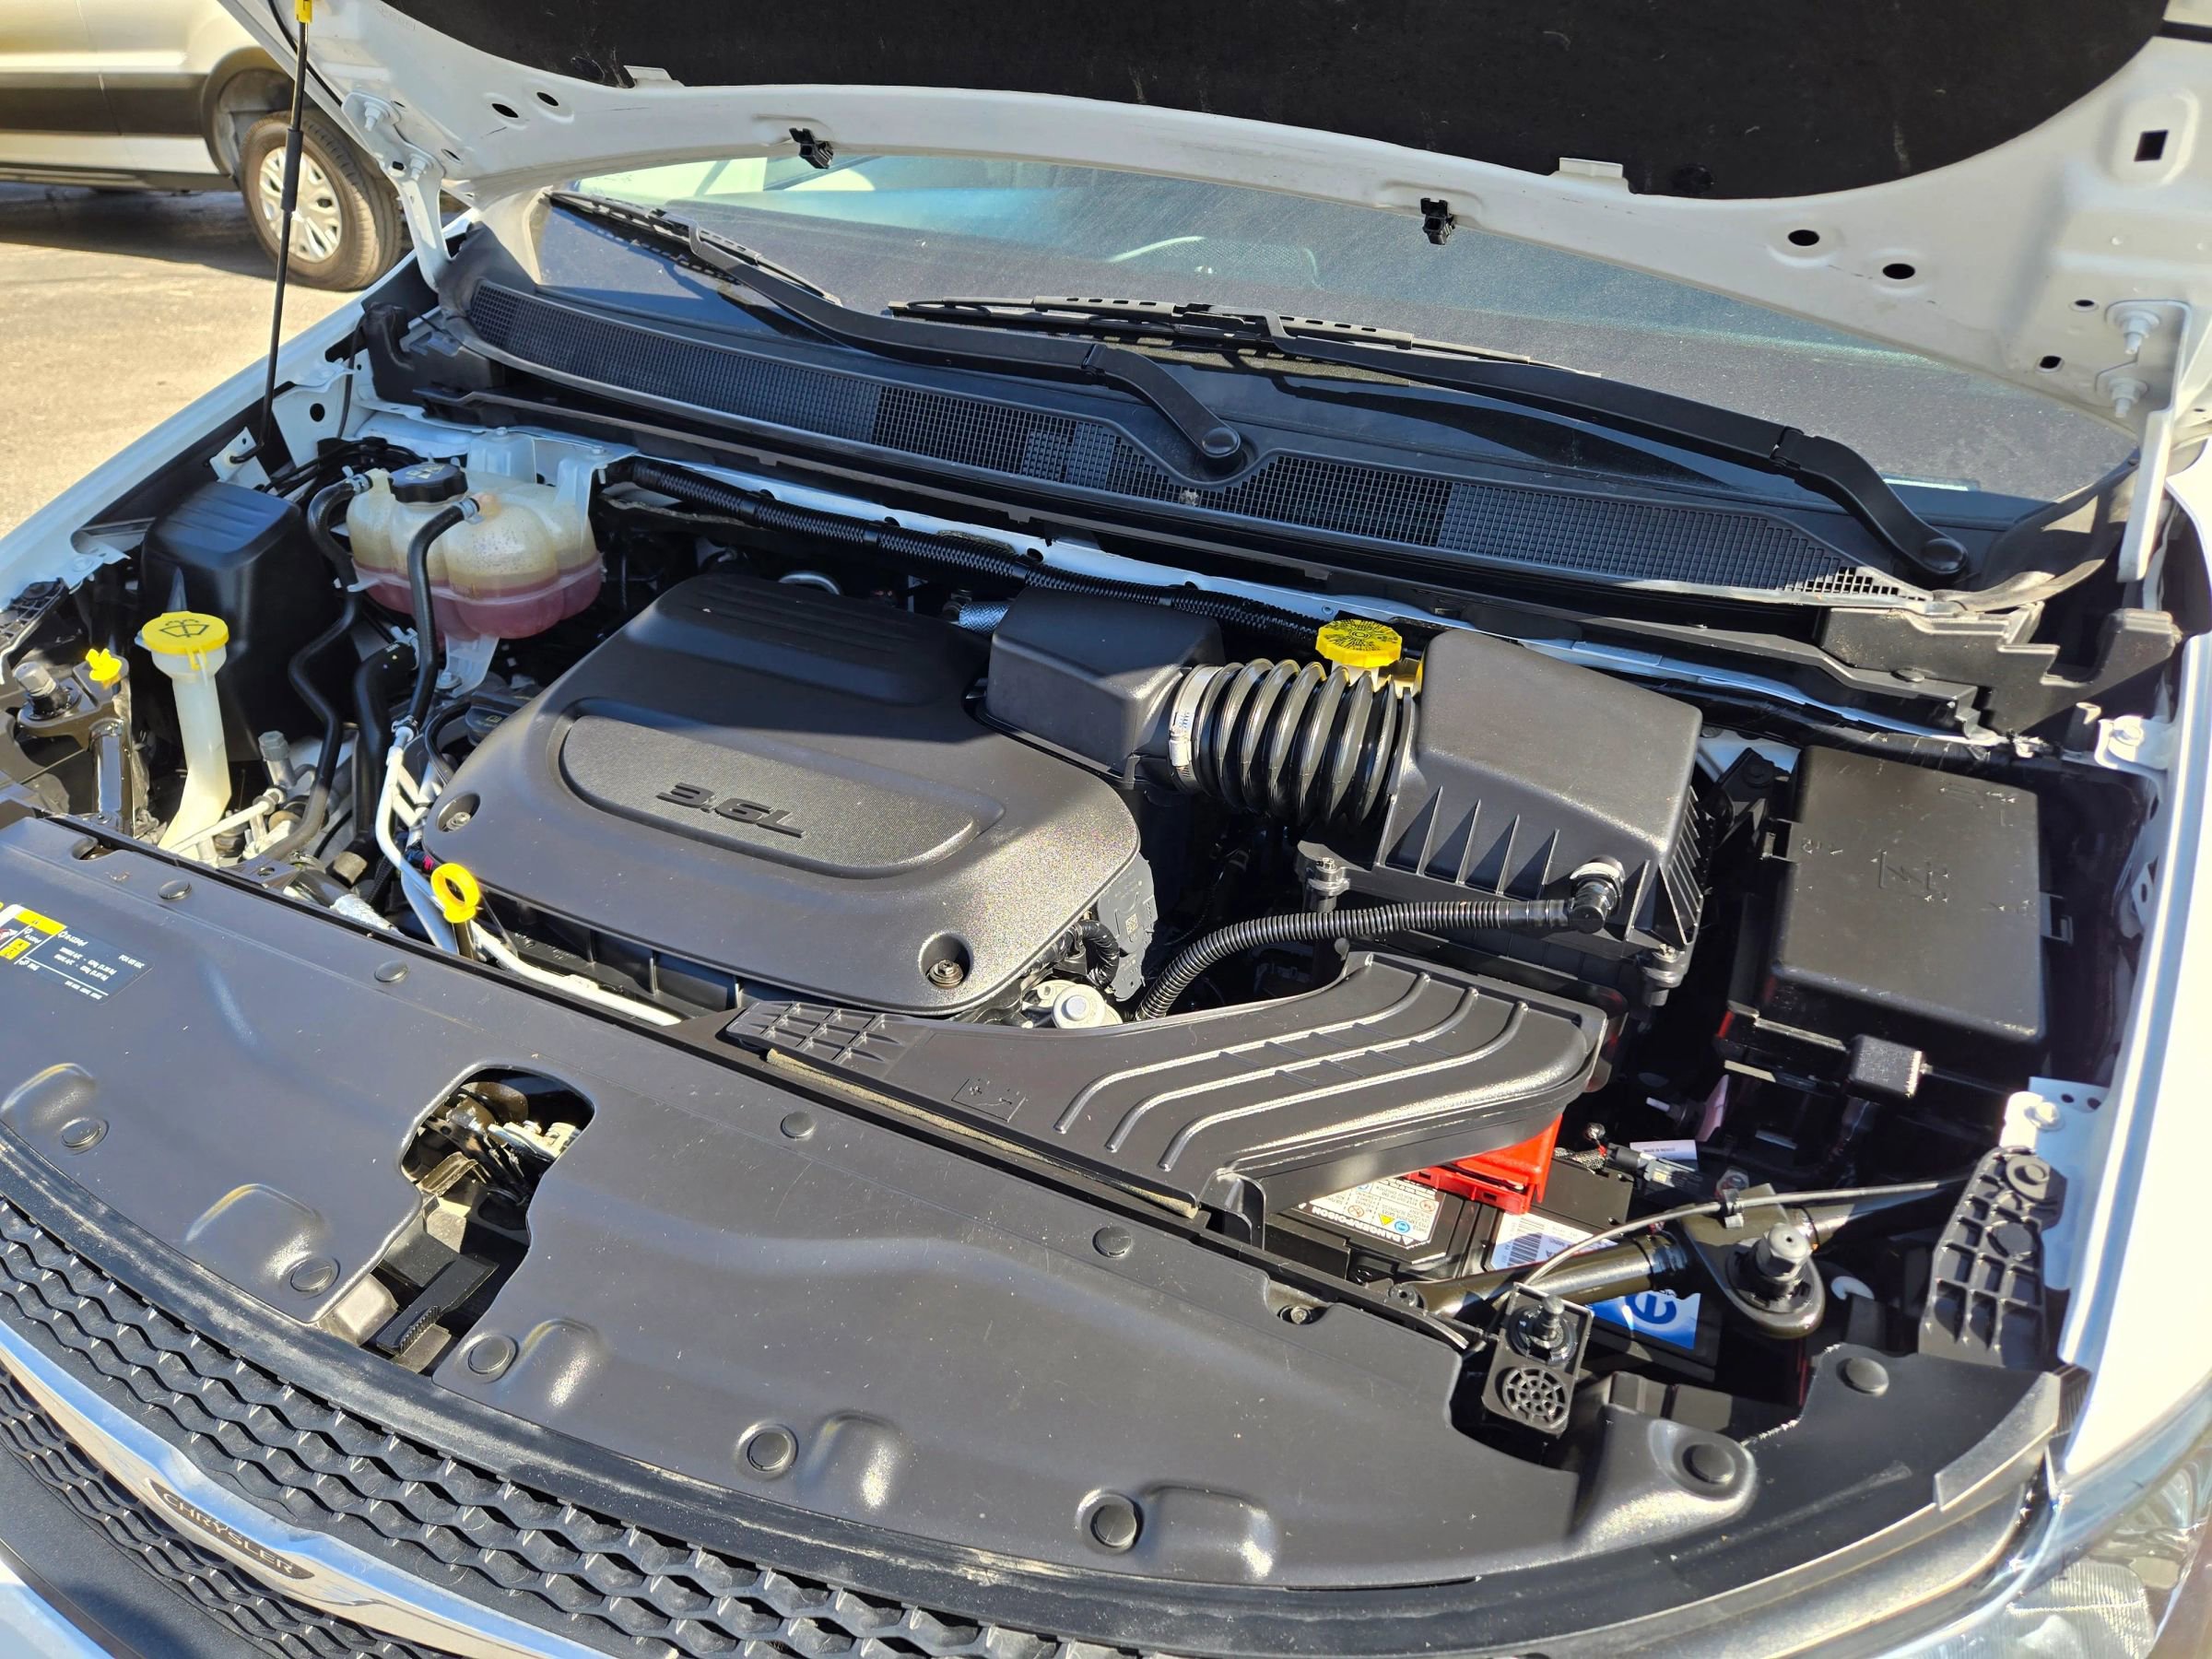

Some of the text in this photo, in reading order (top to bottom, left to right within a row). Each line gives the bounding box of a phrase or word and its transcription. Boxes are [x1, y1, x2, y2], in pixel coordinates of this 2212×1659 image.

[655, 782, 807, 839] 3.6L
[1312, 1206, 1402, 1241] DANGER/POISON
[163, 1492, 293, 1573] CHRYSLER
